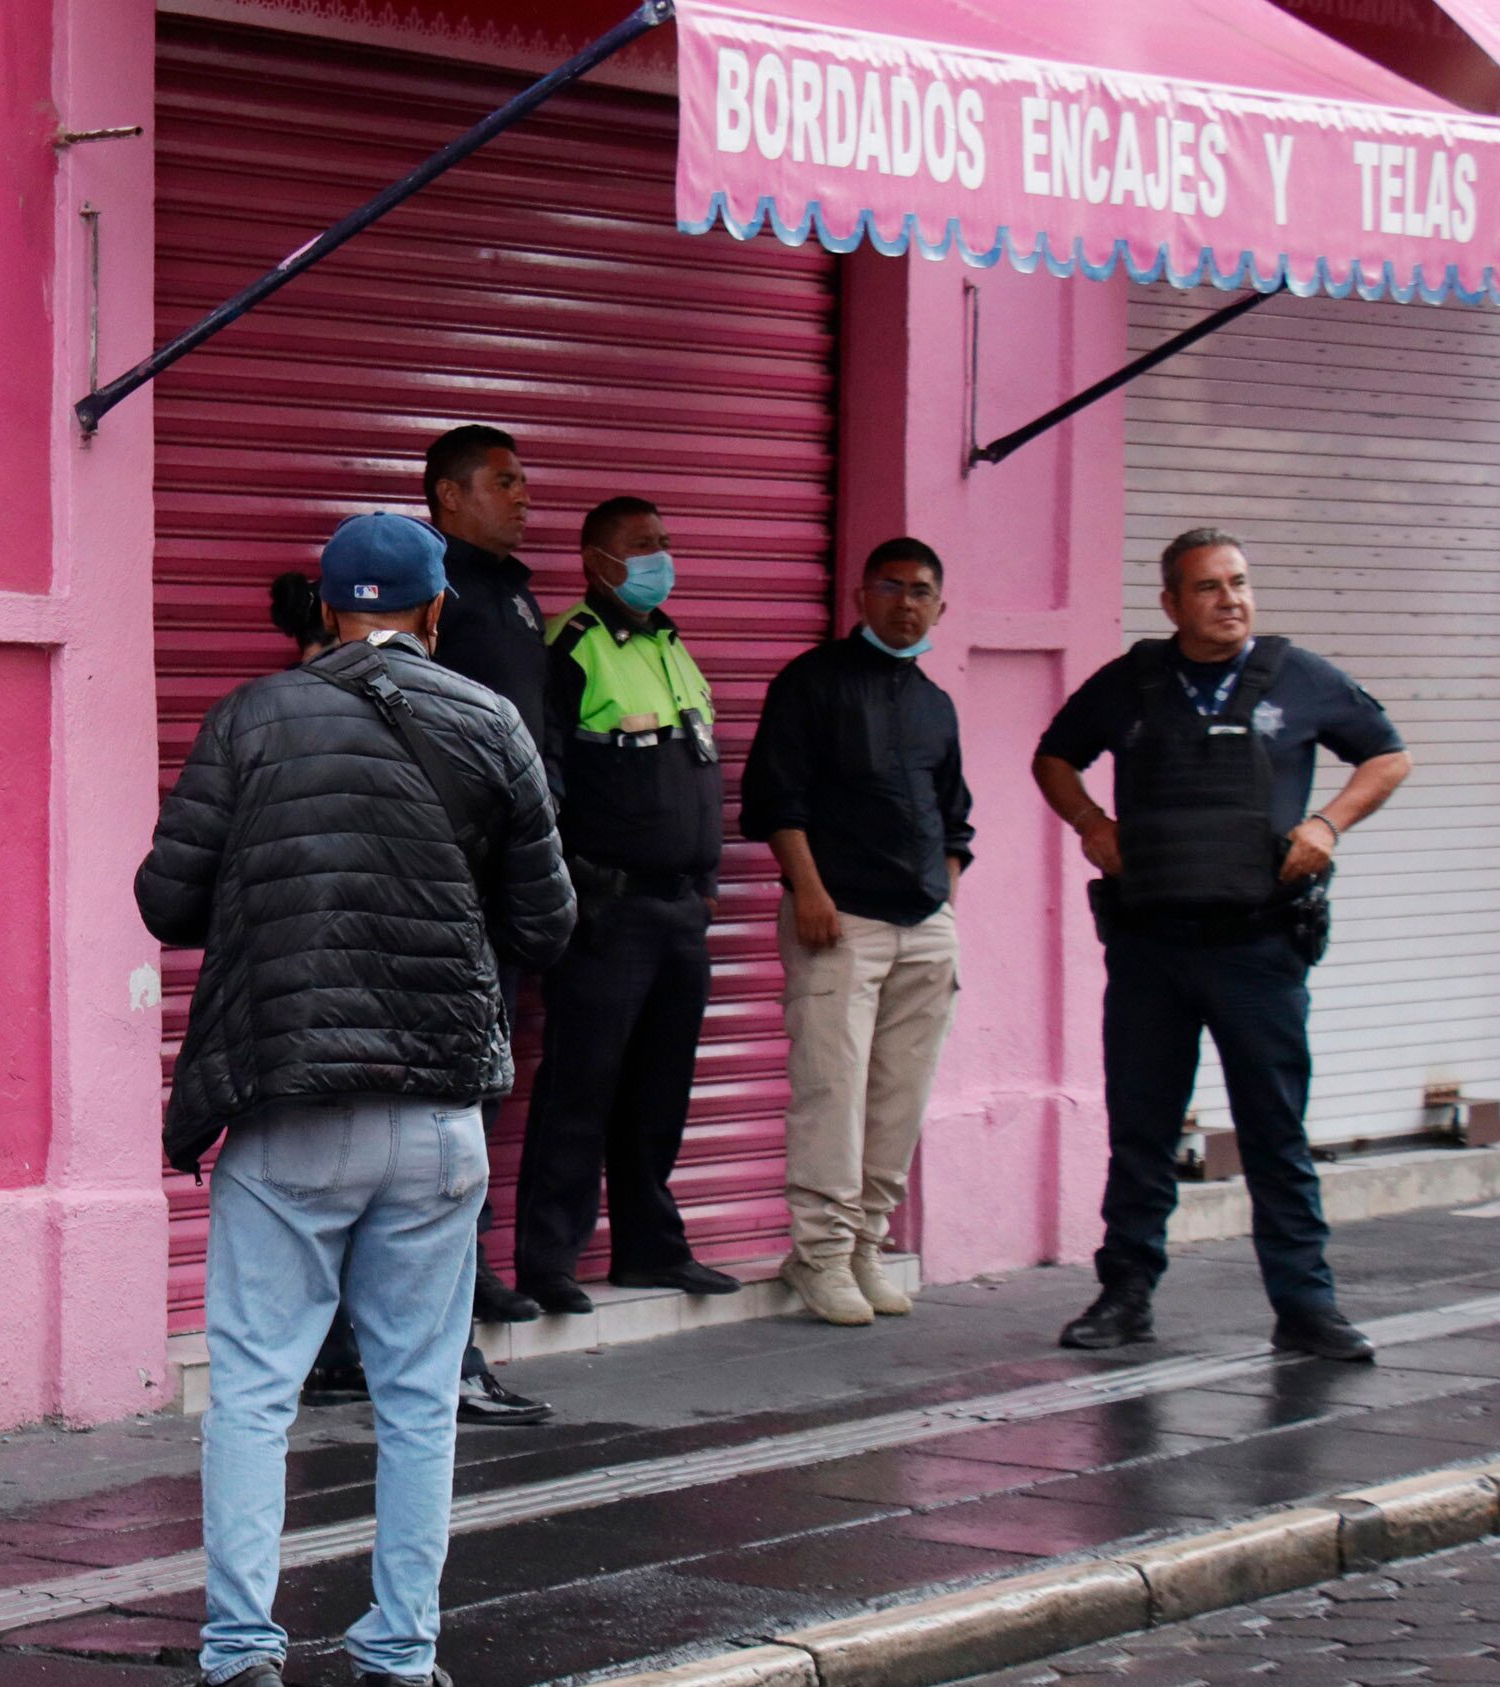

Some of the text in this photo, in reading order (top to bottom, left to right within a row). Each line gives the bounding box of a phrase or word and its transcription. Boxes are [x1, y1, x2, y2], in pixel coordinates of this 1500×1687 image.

[717, 47, 1478, 244] BORDADOS ENCAJES Y TELAS
